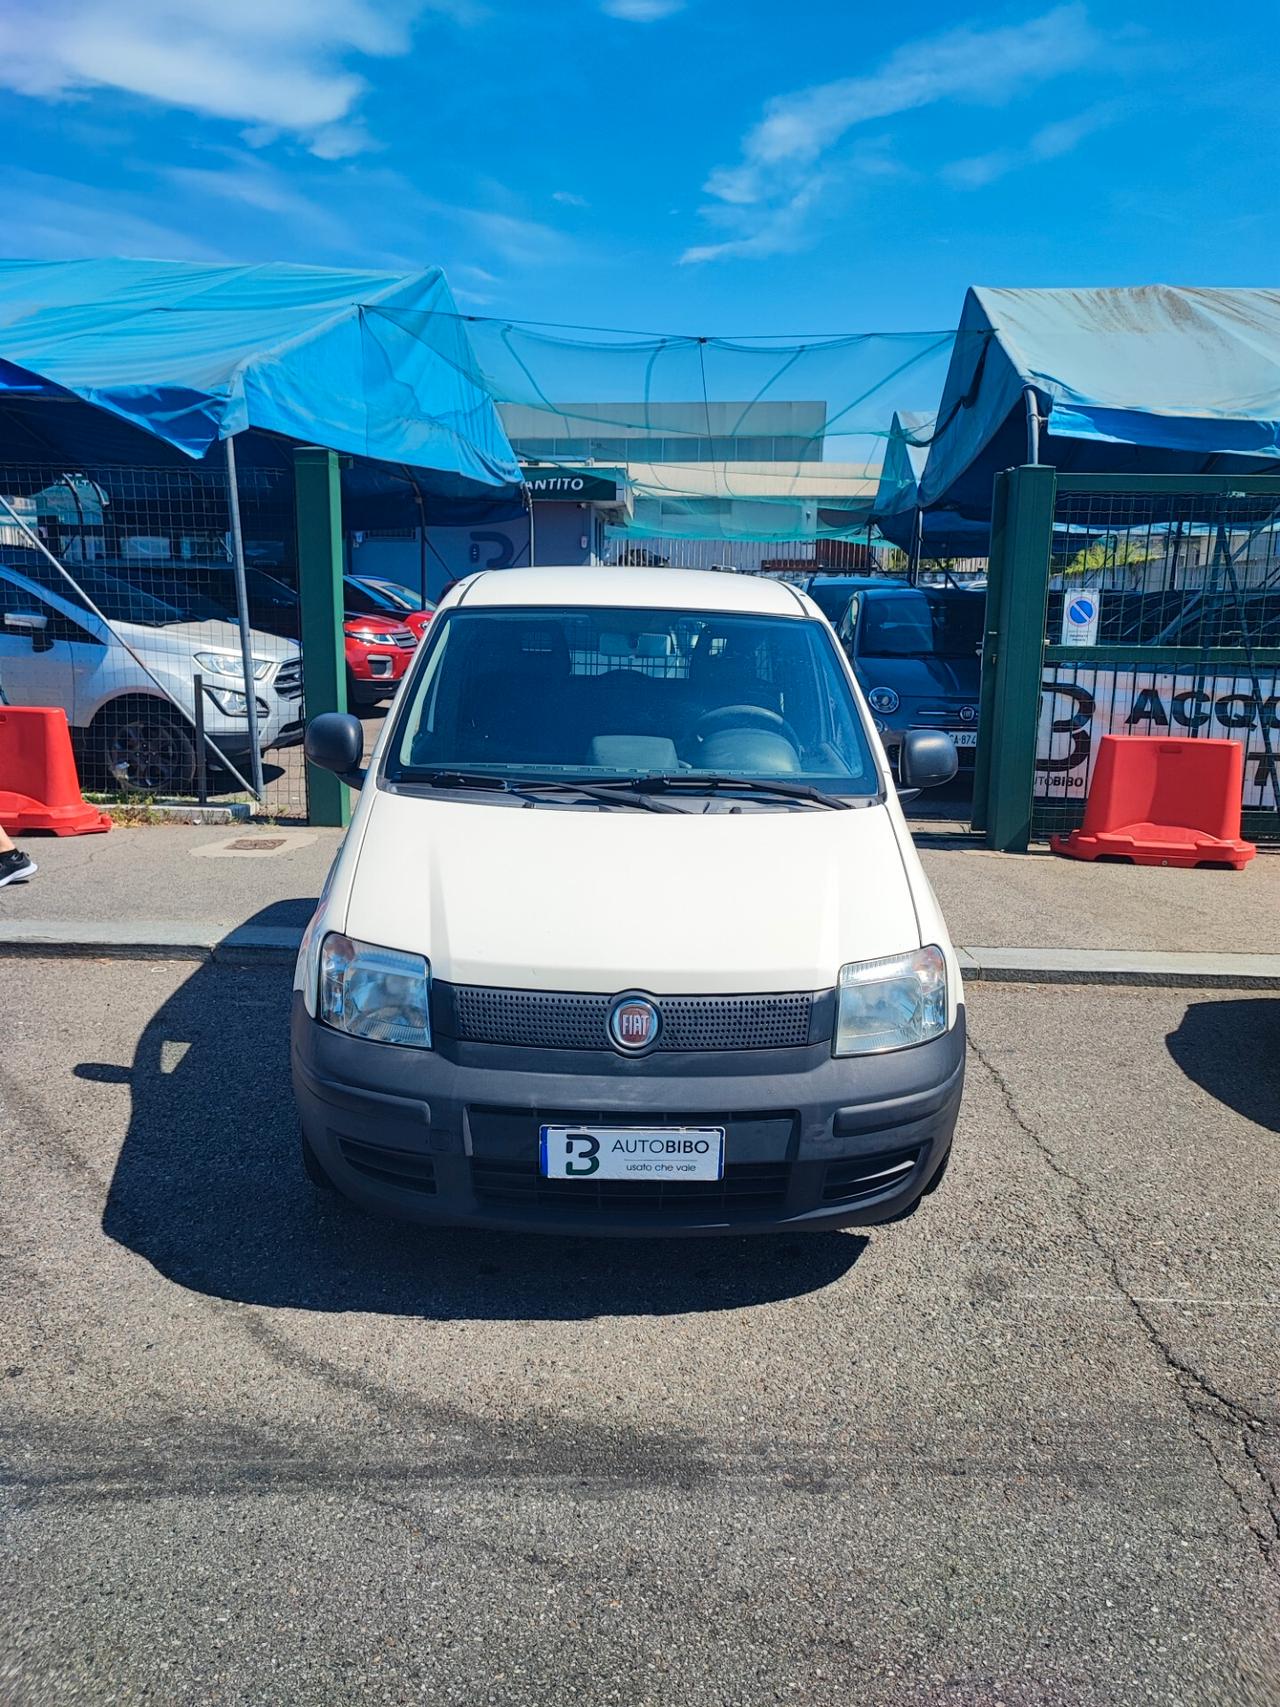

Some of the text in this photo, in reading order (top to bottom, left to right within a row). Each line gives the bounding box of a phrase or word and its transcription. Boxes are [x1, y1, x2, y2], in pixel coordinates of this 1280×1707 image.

[521, 478, 584, 491] ANTITO
[1035, 776, 1083, 787] TOBIBO
[622, 1014, 650, 1035] FIAT
[611, 1139, 710, 1154] AUTOBIBO
[626, 1162, 697, 1172] usato che vale
